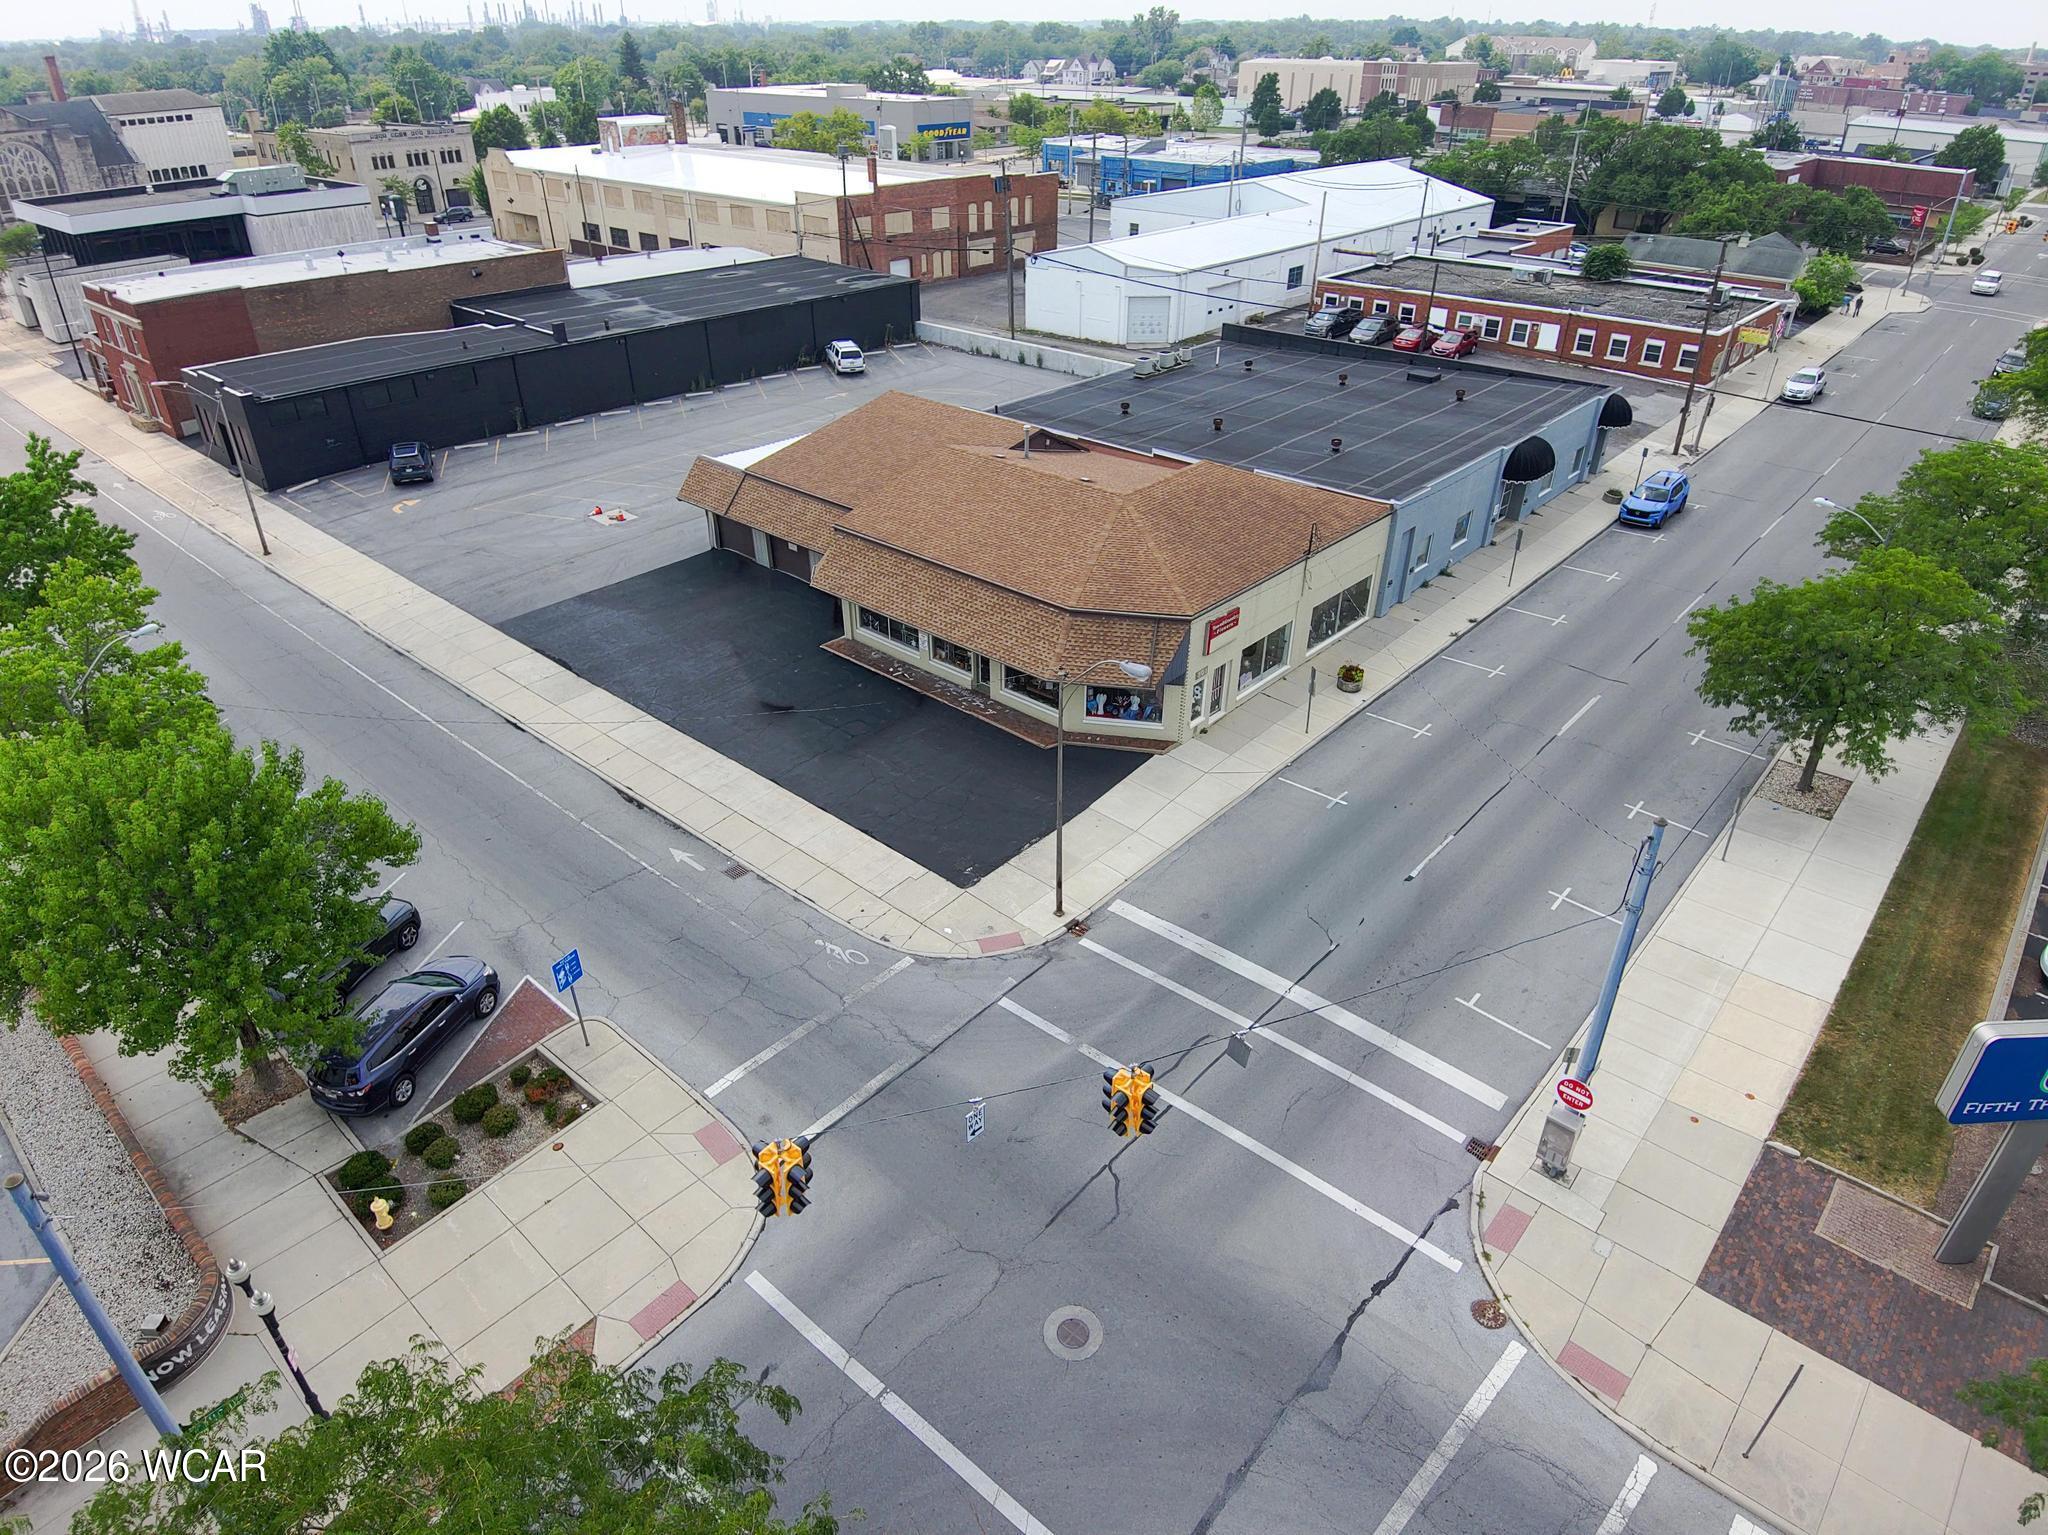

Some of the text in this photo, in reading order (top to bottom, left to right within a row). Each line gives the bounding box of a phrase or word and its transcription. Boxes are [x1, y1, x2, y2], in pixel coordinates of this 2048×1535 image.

[1564, 1080, 1590, 1097] DO NOT
[1562, 1092, 1584, 1108] ENTER
[1962, 1101, 2021, 1115] FIFTH
[968, 1109, 983, 1123] ONE
[968, 1115, 983, 1131] WAY
